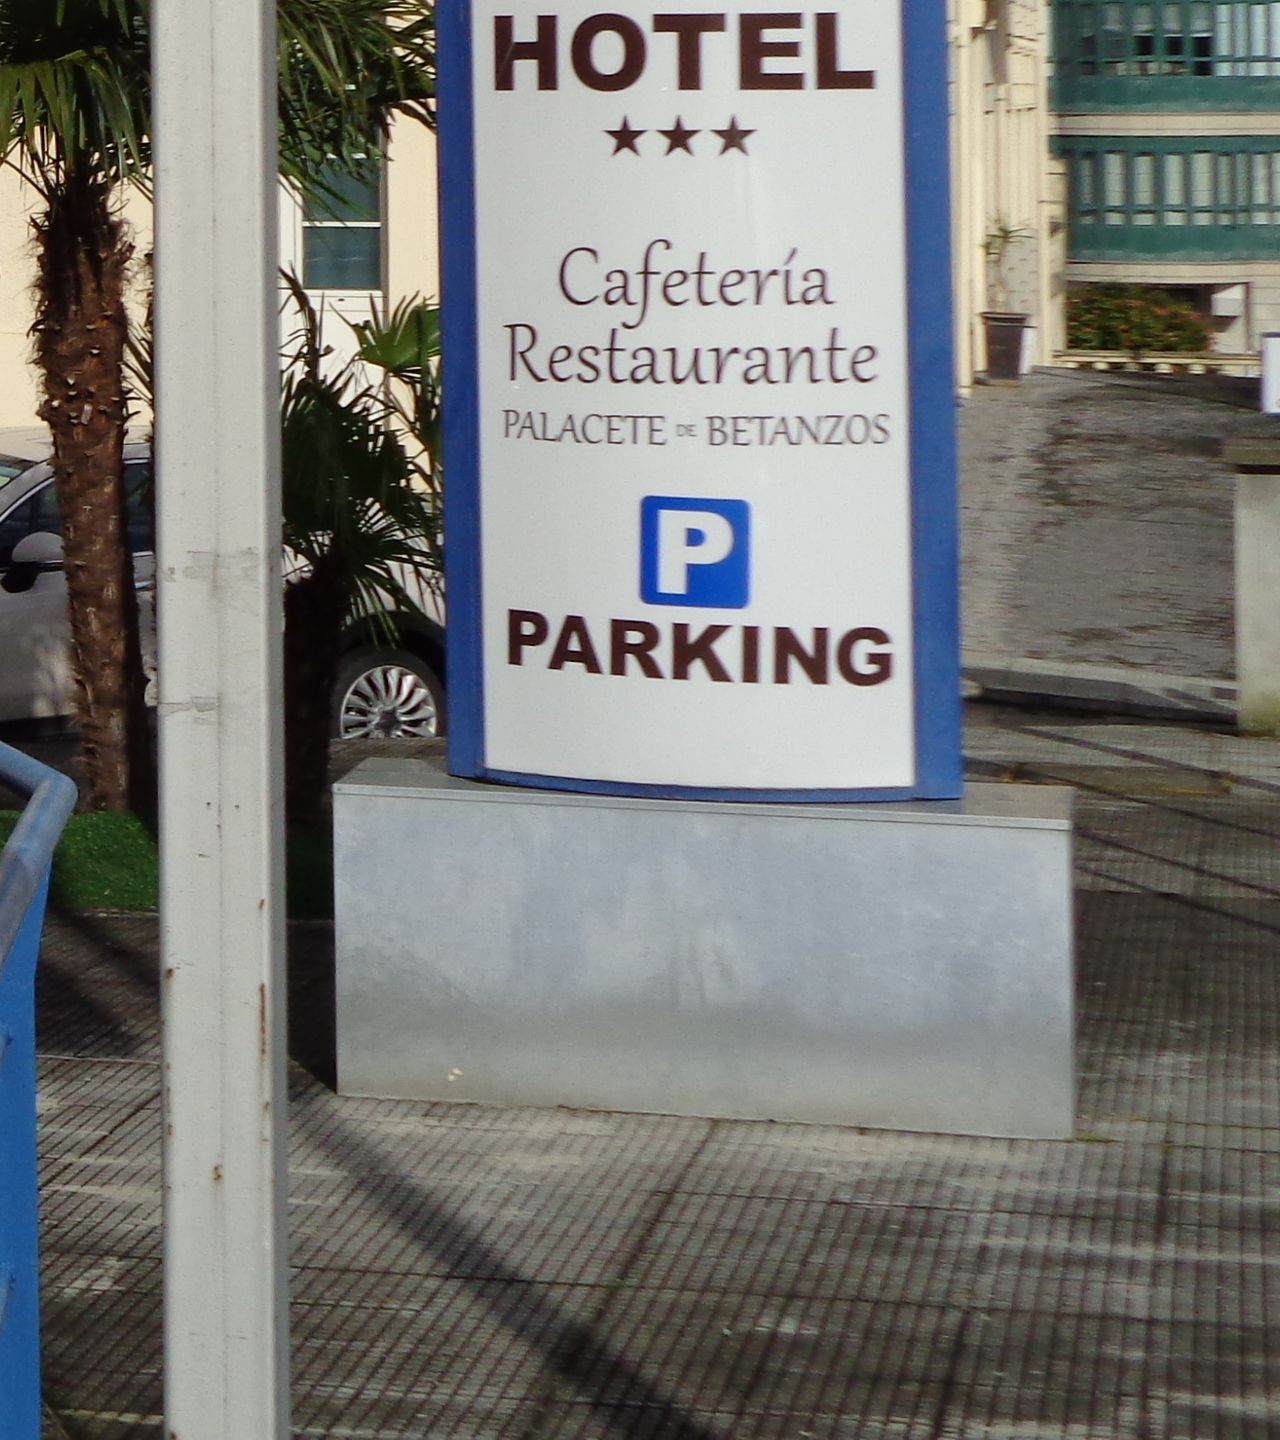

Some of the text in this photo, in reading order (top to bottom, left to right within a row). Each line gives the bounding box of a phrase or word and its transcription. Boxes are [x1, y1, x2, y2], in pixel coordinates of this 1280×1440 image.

[493, 12, 876, 92] HOTEL
[558, 238, 836, 330] Cafetería
[502, 323, 879, 386] Restaurante
[501, 409, 891, 447] PALACETE DE BETANZOS
[655, 509, 735, 595] P
[506, 608, 894, 687] PARKING
